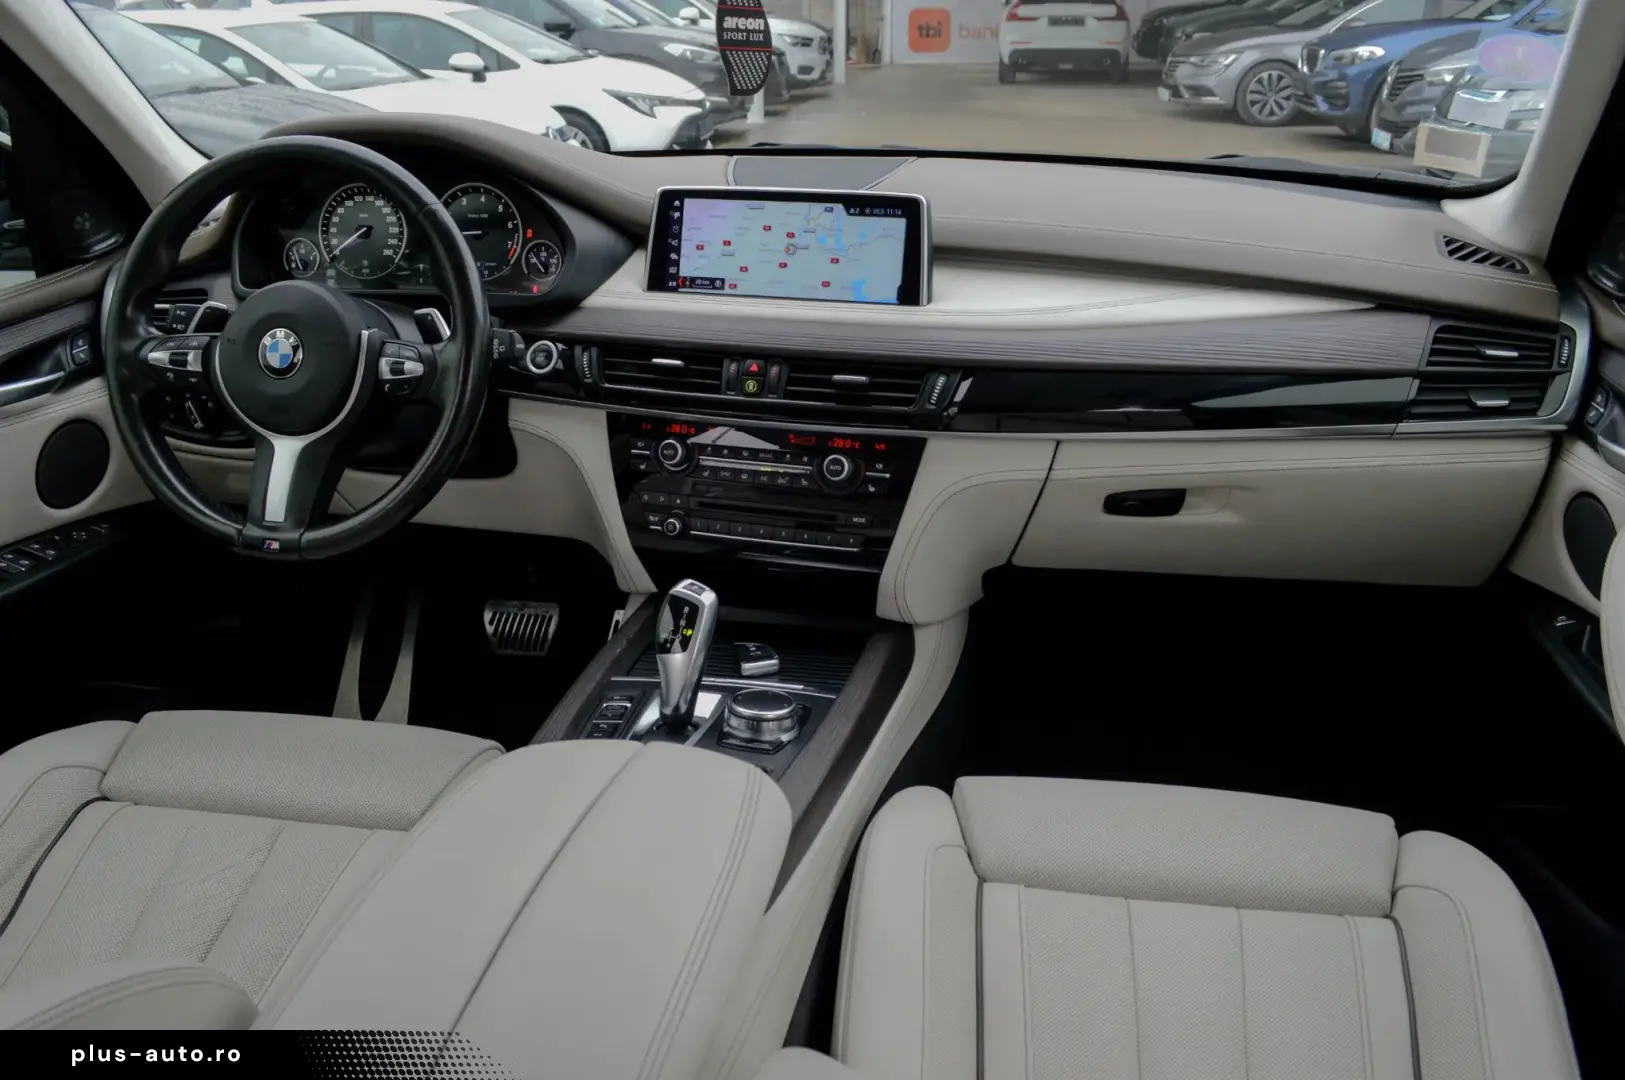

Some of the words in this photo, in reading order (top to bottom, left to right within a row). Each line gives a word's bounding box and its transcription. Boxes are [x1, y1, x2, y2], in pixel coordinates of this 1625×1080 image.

[723, 16, 764, 30] areon
[917, 21, 942, 38] tbi
[723, 32, 747, 40] SPORT
[749, 33, 764, 41] LUX
[480, 195, 485, 203] 4
[263, 330, 298, 346] BMW
[684, 606, 690, 614] R
[680, 619, 685, 627] N
